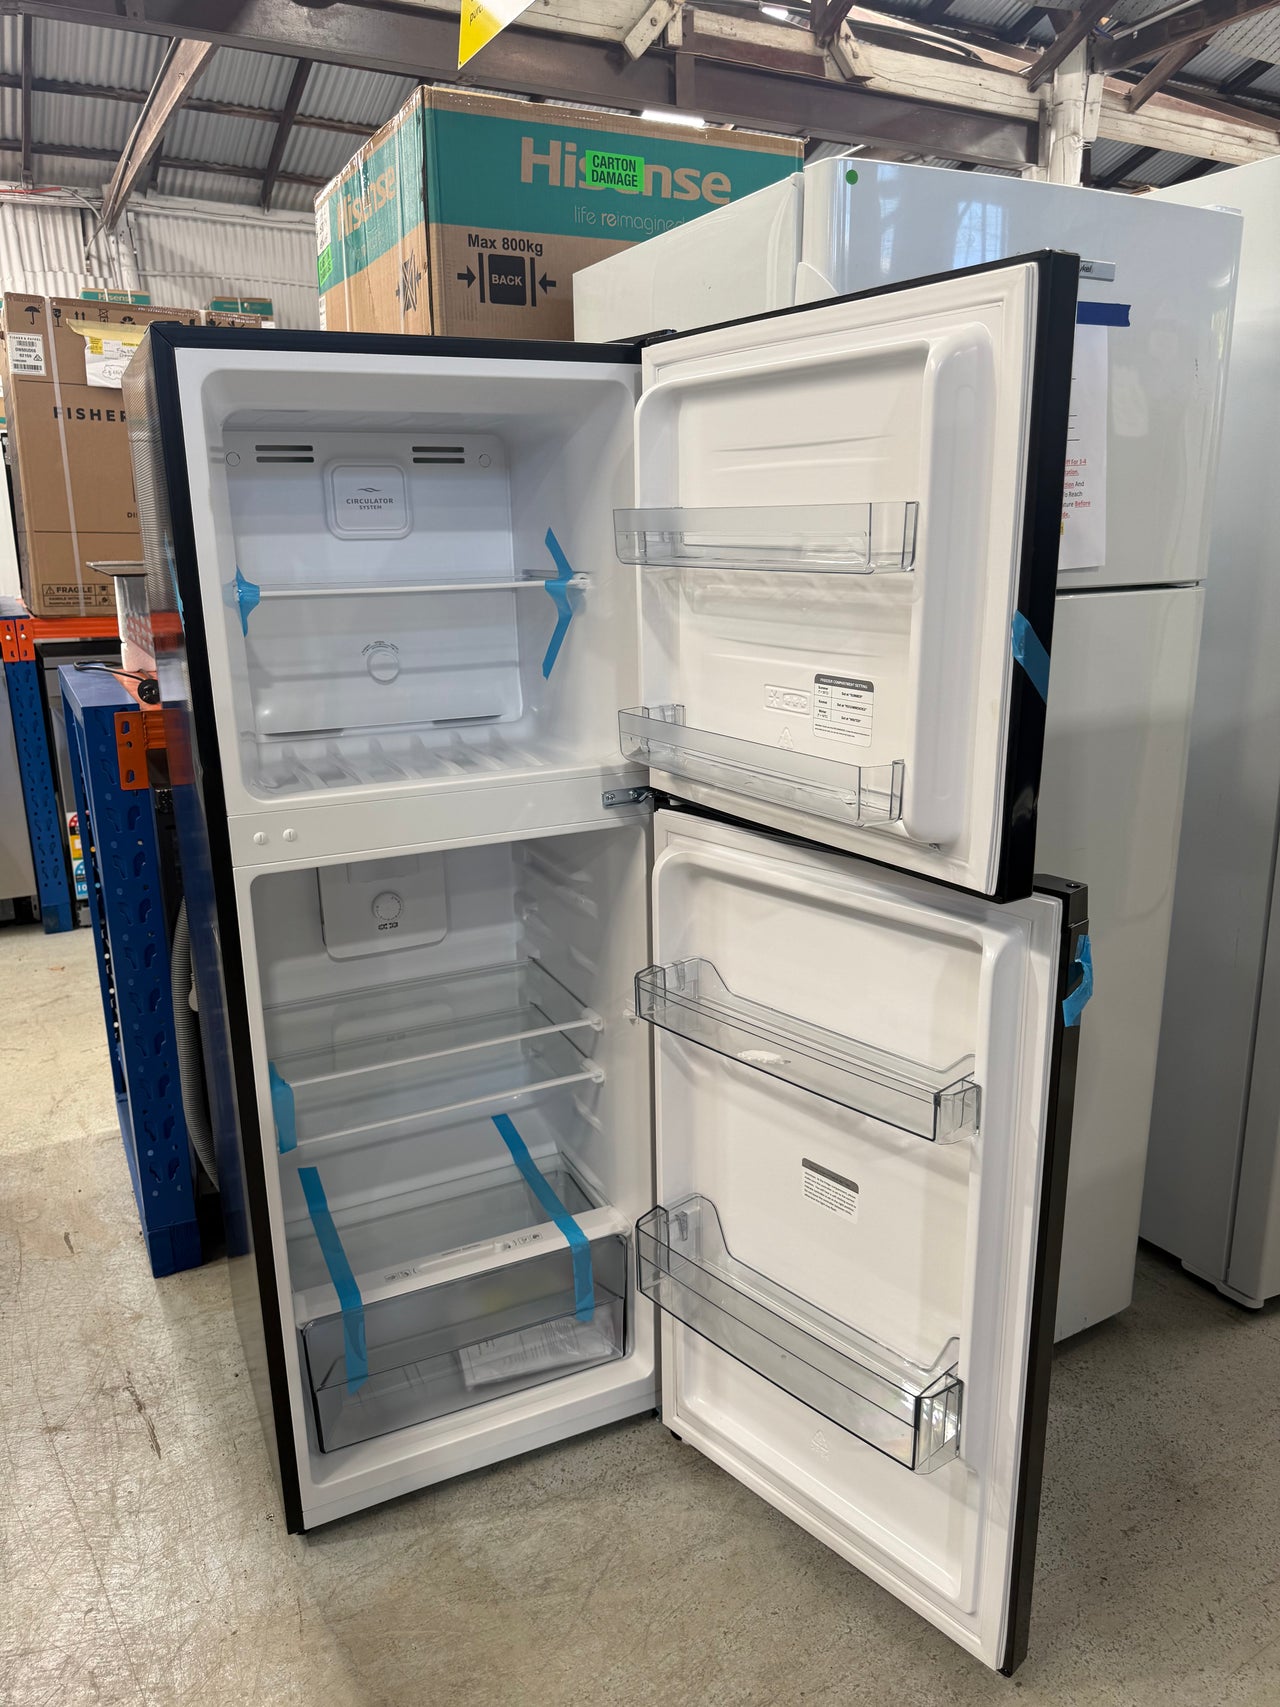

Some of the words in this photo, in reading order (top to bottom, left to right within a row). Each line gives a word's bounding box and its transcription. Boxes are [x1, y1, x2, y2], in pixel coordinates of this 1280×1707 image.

[521, 136, 732, 204] Hinse
[592, 154, 636, 173] CARTON
[592, 169, 638, 188] DAMAGE
[574, 205, 596, 224] life
[468, 233, 497, 249] Max
[502, 237, 543, 256] 800kg
[491, 274, 522, 286] BACK
[98, 293, 135, 302] Hsense
